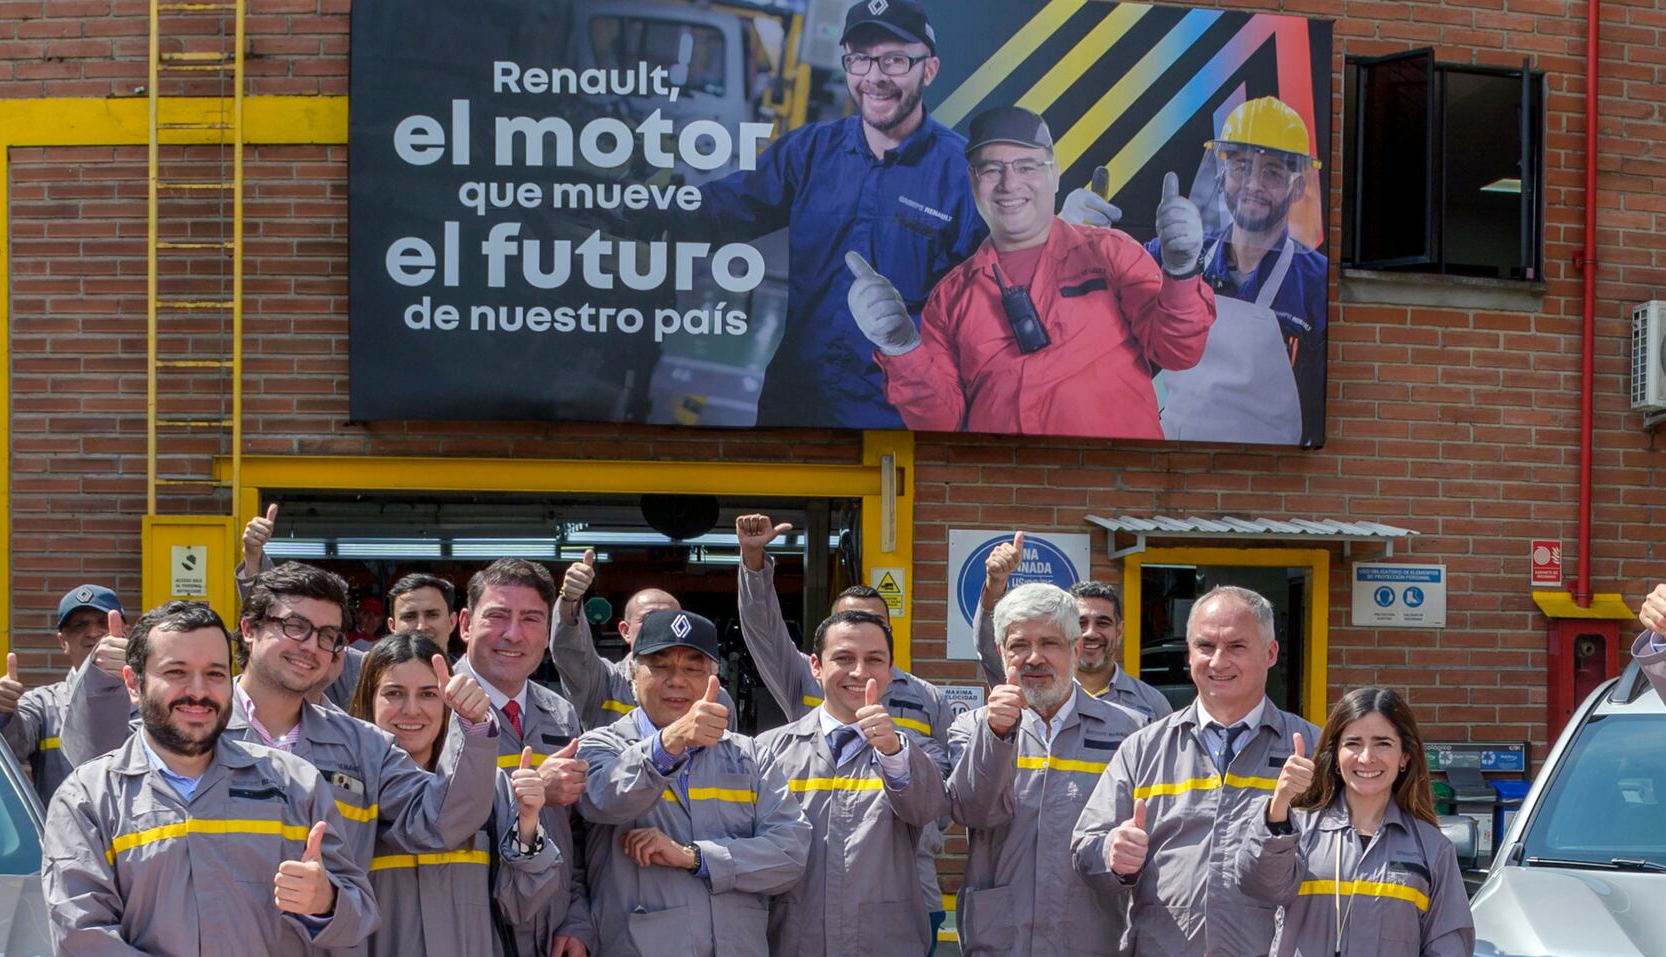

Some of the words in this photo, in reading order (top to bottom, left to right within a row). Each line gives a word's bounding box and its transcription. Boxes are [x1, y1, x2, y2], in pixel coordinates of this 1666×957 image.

[493, 61, 680, 102] Renault,
[393, 99, 468, 170] el
[494, 108, 775, 171] motor
[458, 181, 541, 216] que
[553, 181, 703, 211] mueve
[385, 220, 460, 288] el
[481, 222, 766, 293] futuro
[404, 296, 460, 330] de
[470, 302, 644, 333] nuestro
[654, 301, 748, 342] país
[1424, 744, 1452, 753] cológico
